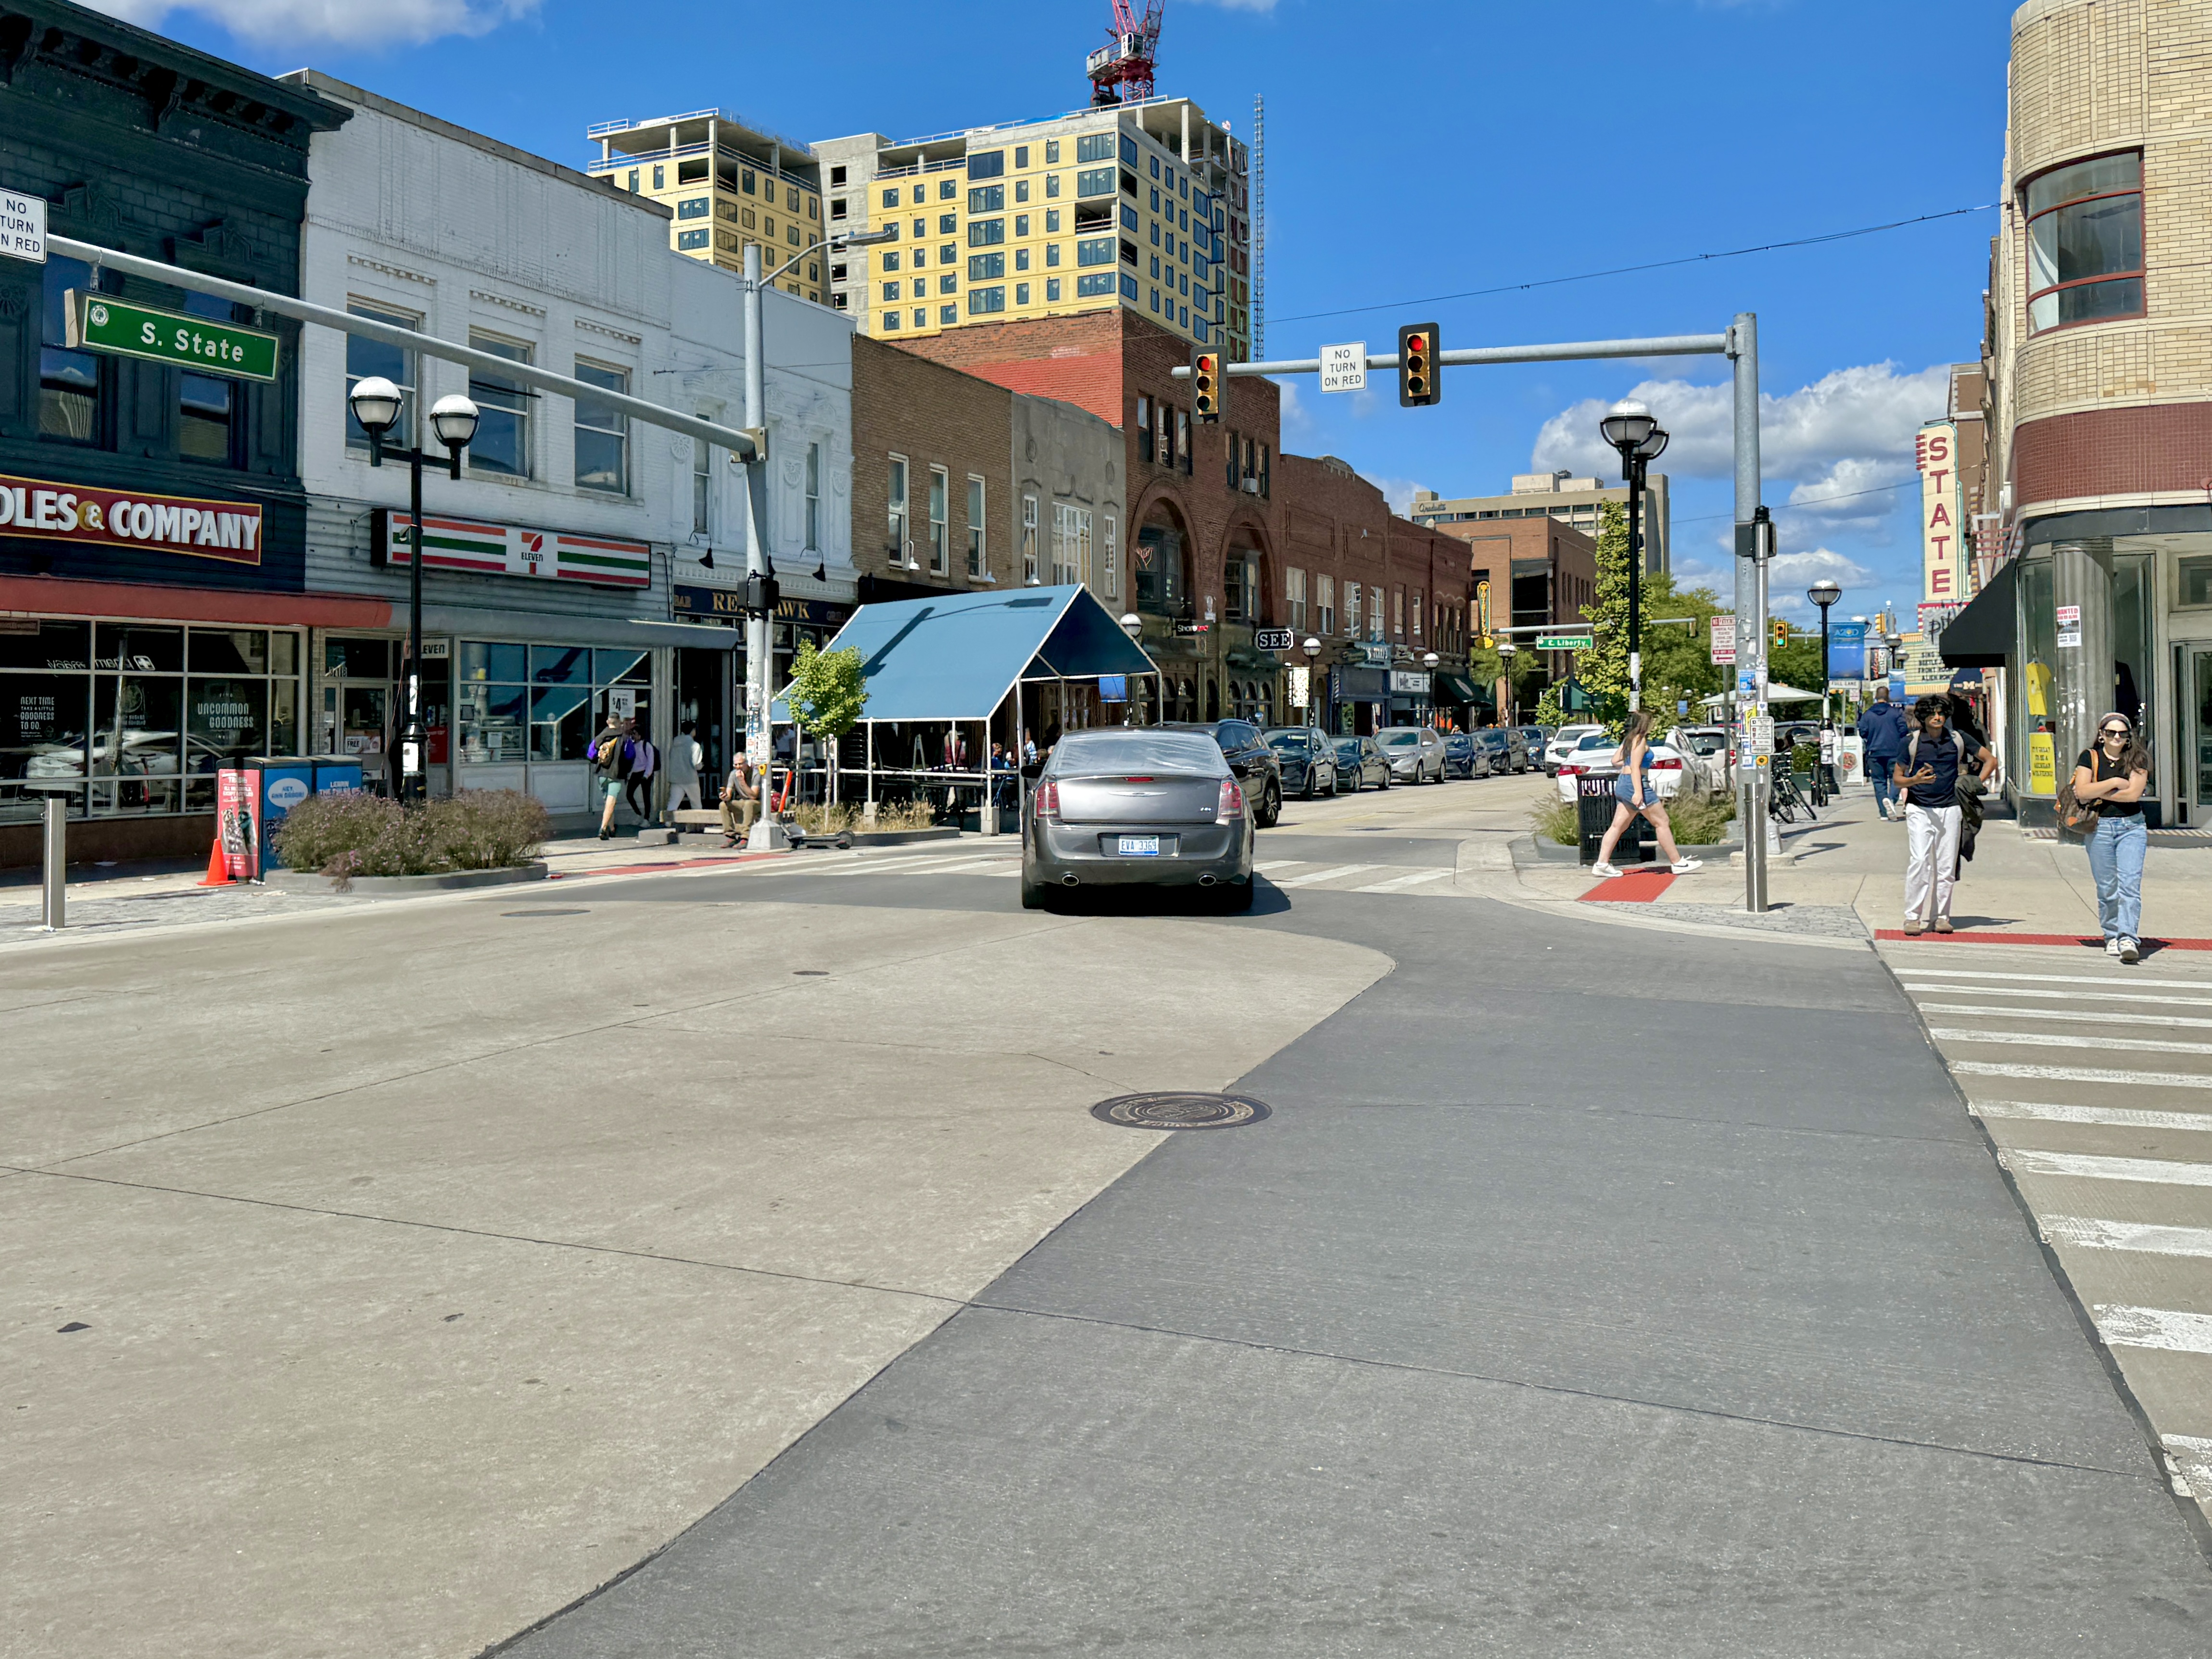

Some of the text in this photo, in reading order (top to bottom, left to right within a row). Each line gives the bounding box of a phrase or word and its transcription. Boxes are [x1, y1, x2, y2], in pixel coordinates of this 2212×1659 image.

[7, 198, 26, 214] NO
[0, 215, 33, 234] TURN
[15, 237, 39, 252] RED
[140, 322, 243, 362] S. State
[1335, 350, 1350, 359] NO
[1330, 362, 1355, 373] TURN
[1325, 375, 1361, 387] ON RED
[1929, 436, 1951, 594] STATE
[109, 501, 260, 550] COMPANY
[713, 592, 810, 620] REAWK
[1260, 633, 1289, 646] SEE
[1963, 681, 1975, 690] M
[21, 697, 54, 705] NEXT TIME
[198, 703, 249, 715] UNCOMMON
[20, 712, 54, 720] GOODNESS
[209, 716, 254, 728] GOODNESS
[21, 722, 28, 730] TO
[1122, 840, 1156, 850] EVA 3369
